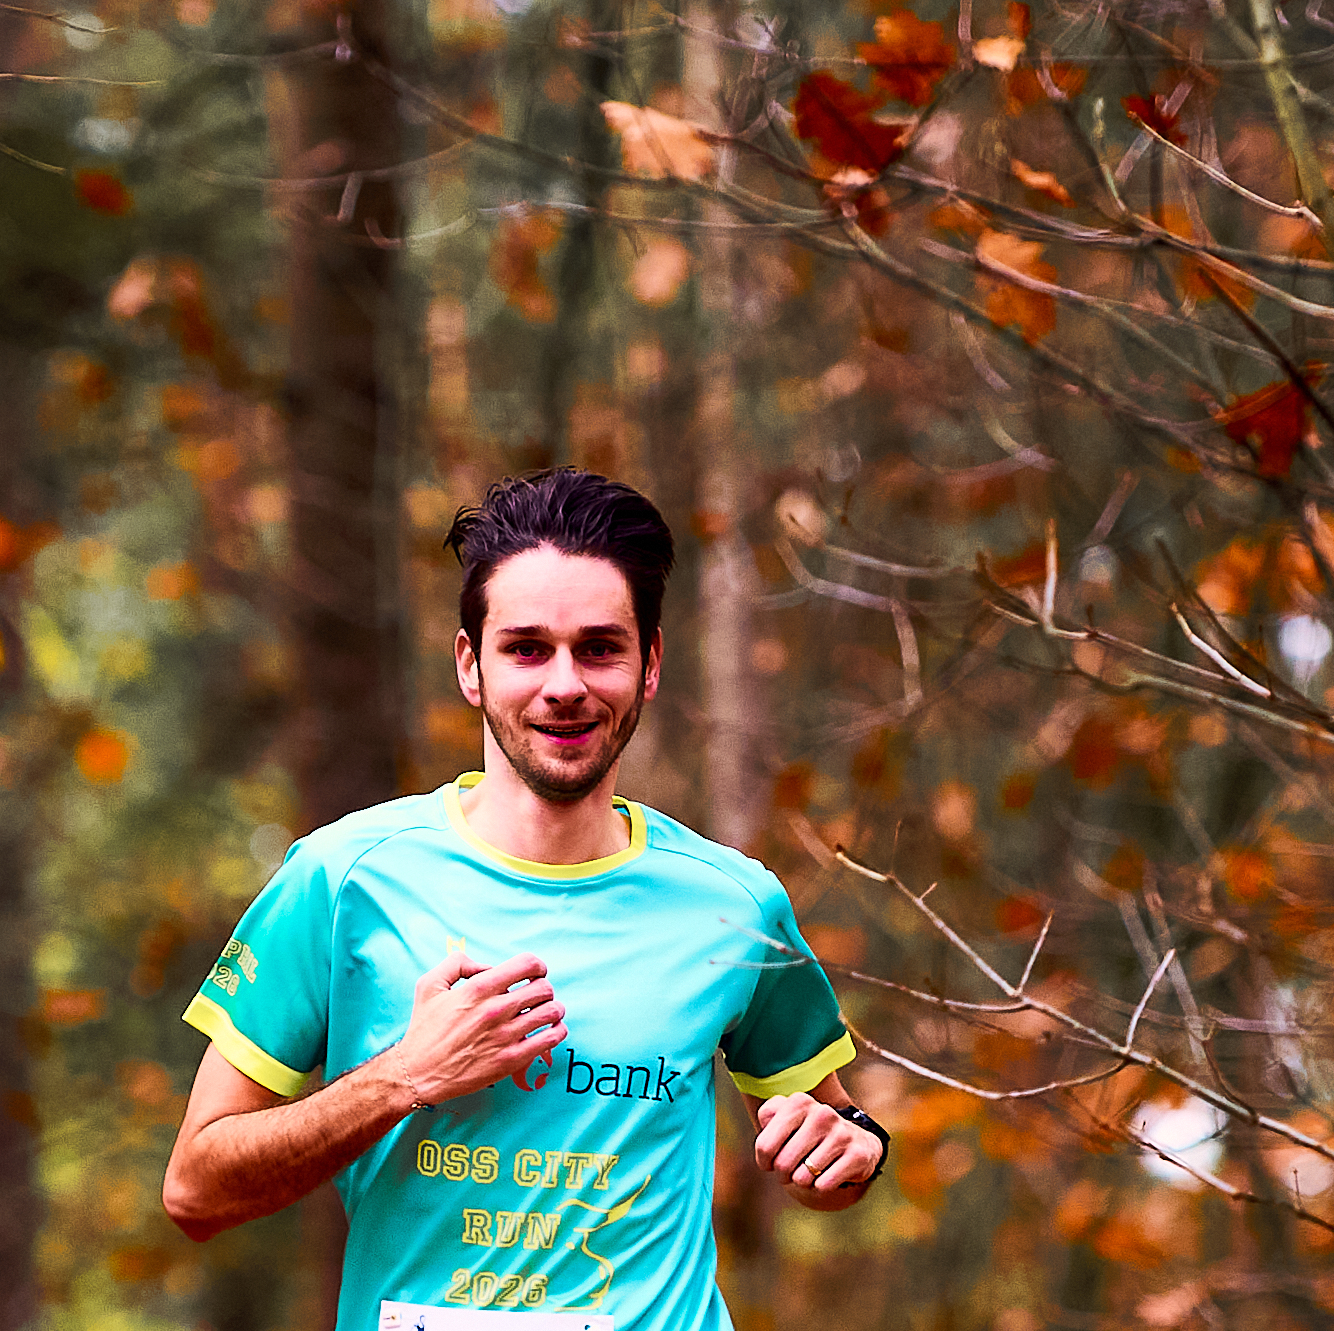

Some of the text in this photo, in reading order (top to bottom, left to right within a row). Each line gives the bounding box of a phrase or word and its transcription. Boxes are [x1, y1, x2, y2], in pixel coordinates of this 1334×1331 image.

[566, 1048, 681, 1103] bank
[417, 1139, 620, 1190] OSS CITY
[461, 1207, 562, 1250] RUN
[444, 1268, 549, 1308] 2026
